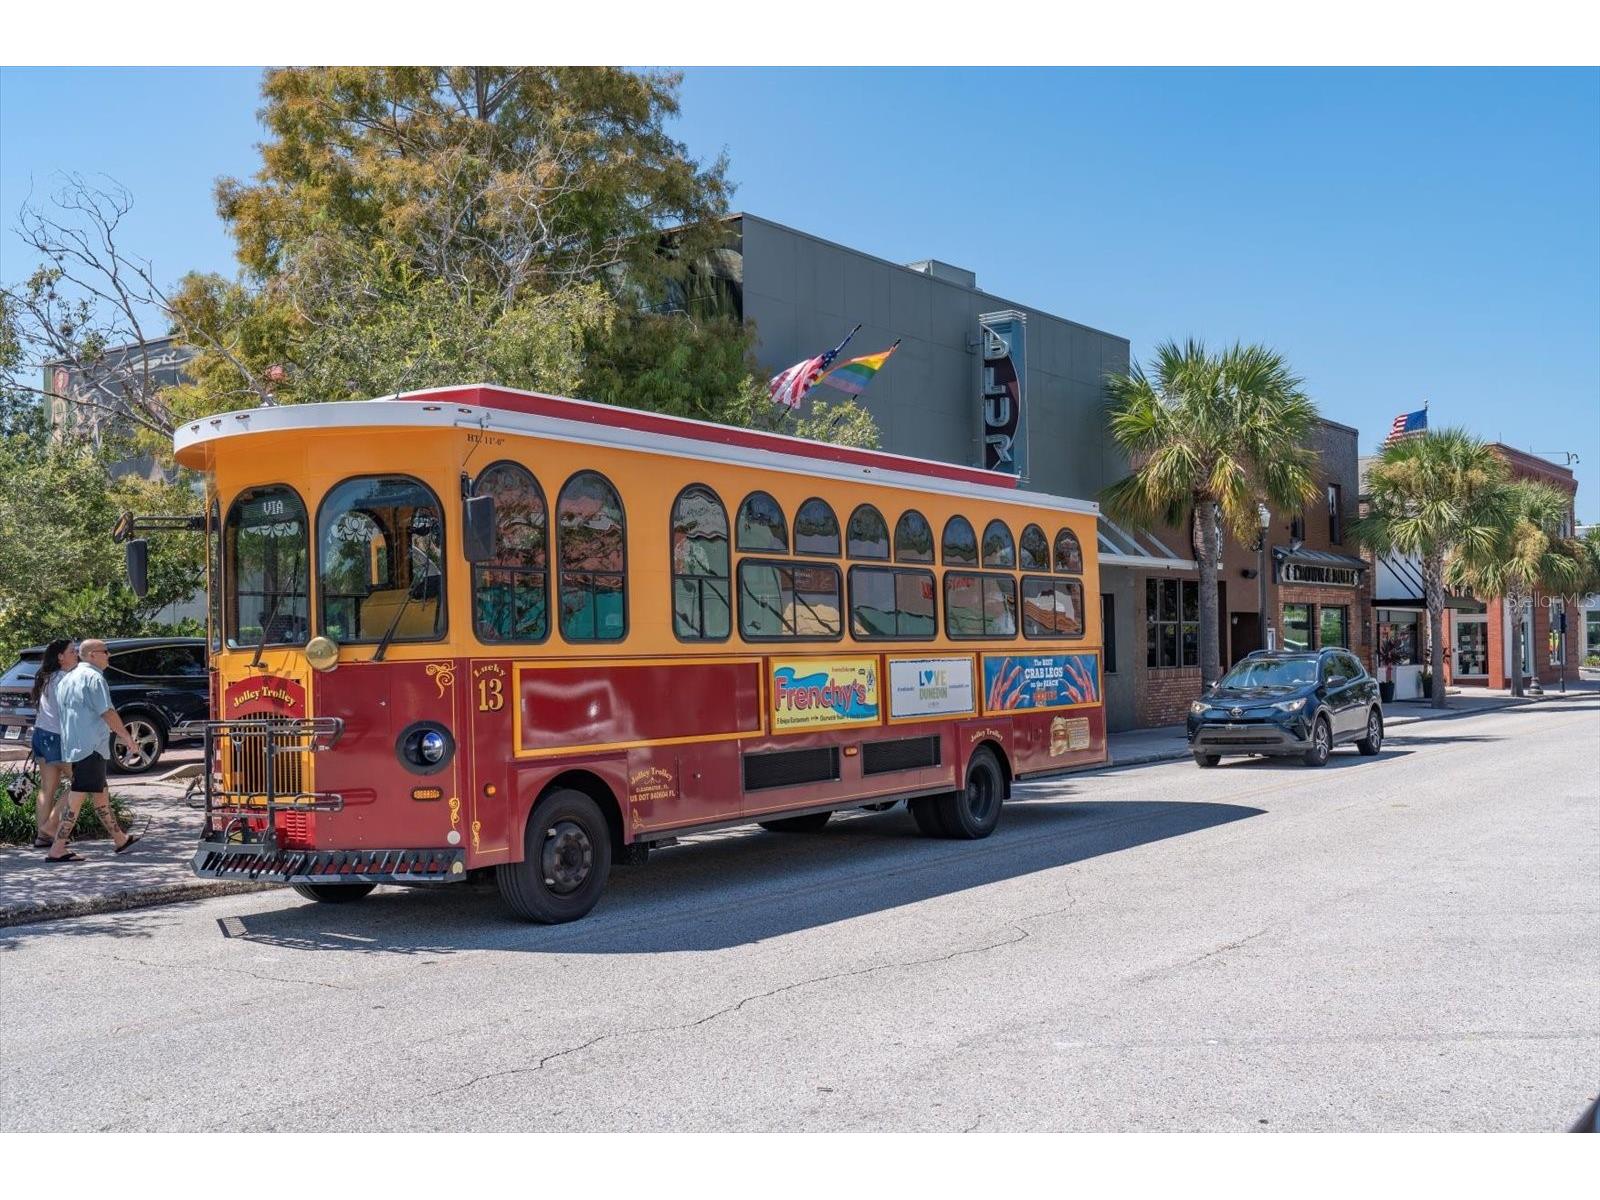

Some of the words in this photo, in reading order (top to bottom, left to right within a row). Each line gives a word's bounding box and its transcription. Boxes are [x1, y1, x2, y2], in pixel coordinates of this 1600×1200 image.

[263, 500, 284, 515] VIA
[473, 663, 506, 678] Lucky
[1024, 667, 1045, 679] CRAB
[1045, 666, 1063, 678] LEGS
[233, 688, 260, 708] Jolley
[261, 685, 296, 707] Trolley
[479, 678, 504, 711] 13
[774, 676, 867, 713] Frenchy's
[651, 766, 673, 781] Trolley
